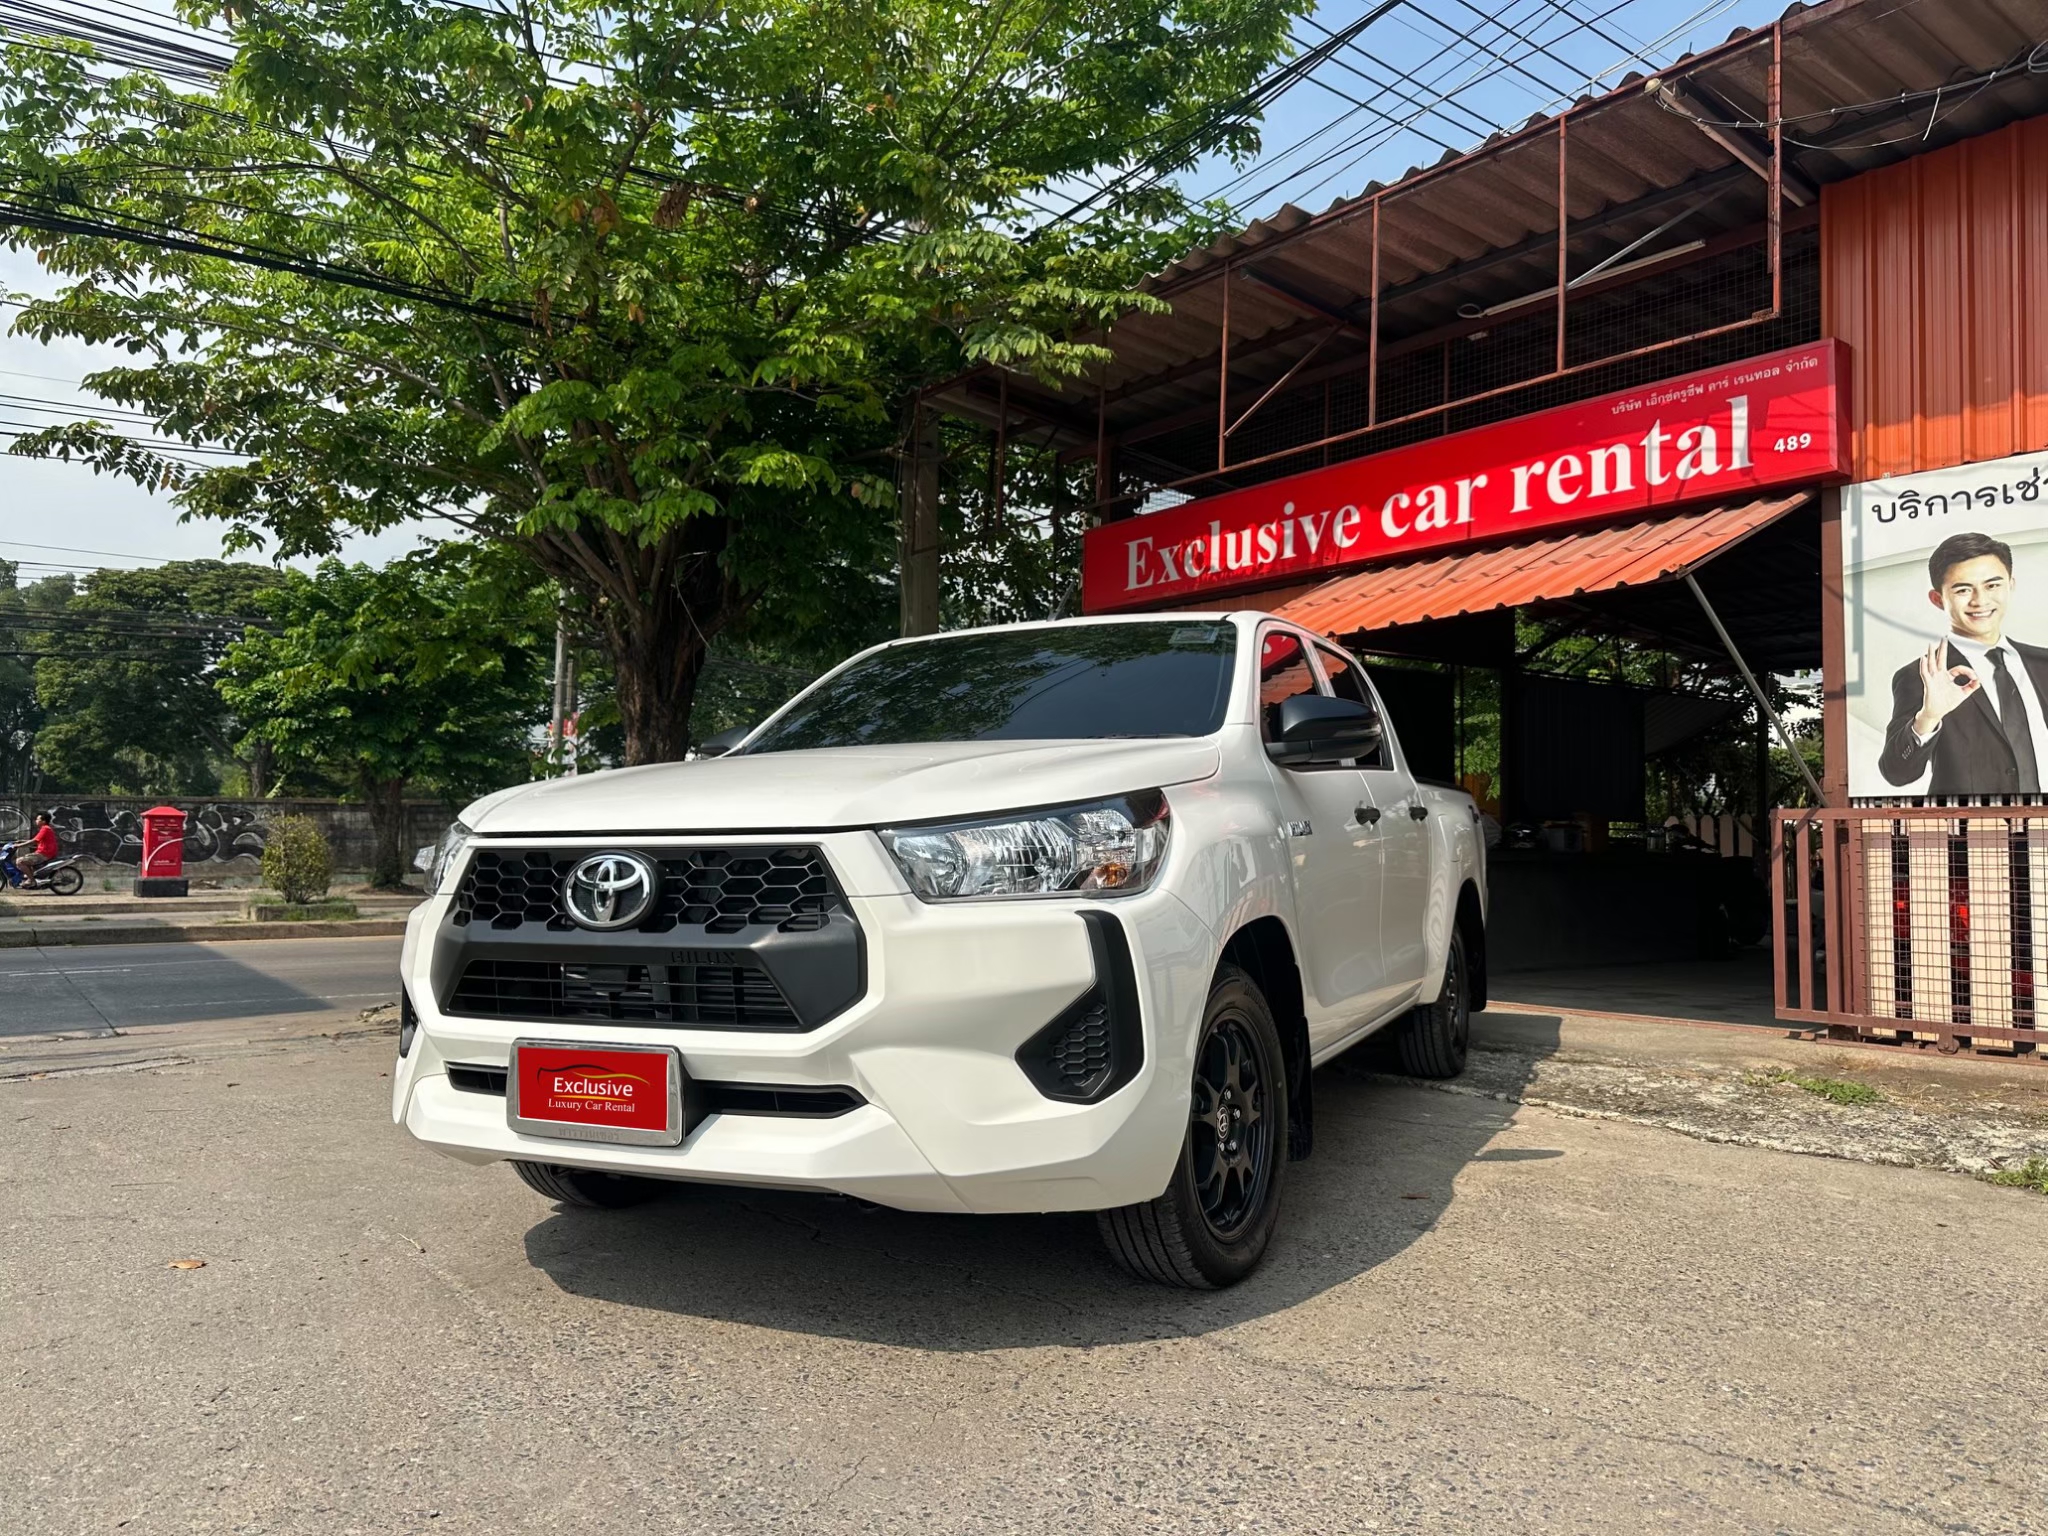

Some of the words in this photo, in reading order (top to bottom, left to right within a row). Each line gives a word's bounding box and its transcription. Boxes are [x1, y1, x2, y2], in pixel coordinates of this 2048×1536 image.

[1611, 399, 1642, 415] บริษัท
[1708, 376, 1729, 393] คาร์
[1733, 365, 1780, 386] เรนทอล
[1785, 355, 1818, 373] จำกัด
[1773, 432, 1812, 454] 489
[1124, 501, 1362, 590] Exclusive
[1380, 470, 1488, 538] car
[1510, 394, 1754, 513] rental
[554, 1077, 633, 1097] Exclusive
[548, 1098, 582, 1112] Luxury
[585, 1102, 602, 1111] Car
[604, 1102, 635, 1113] Rental
